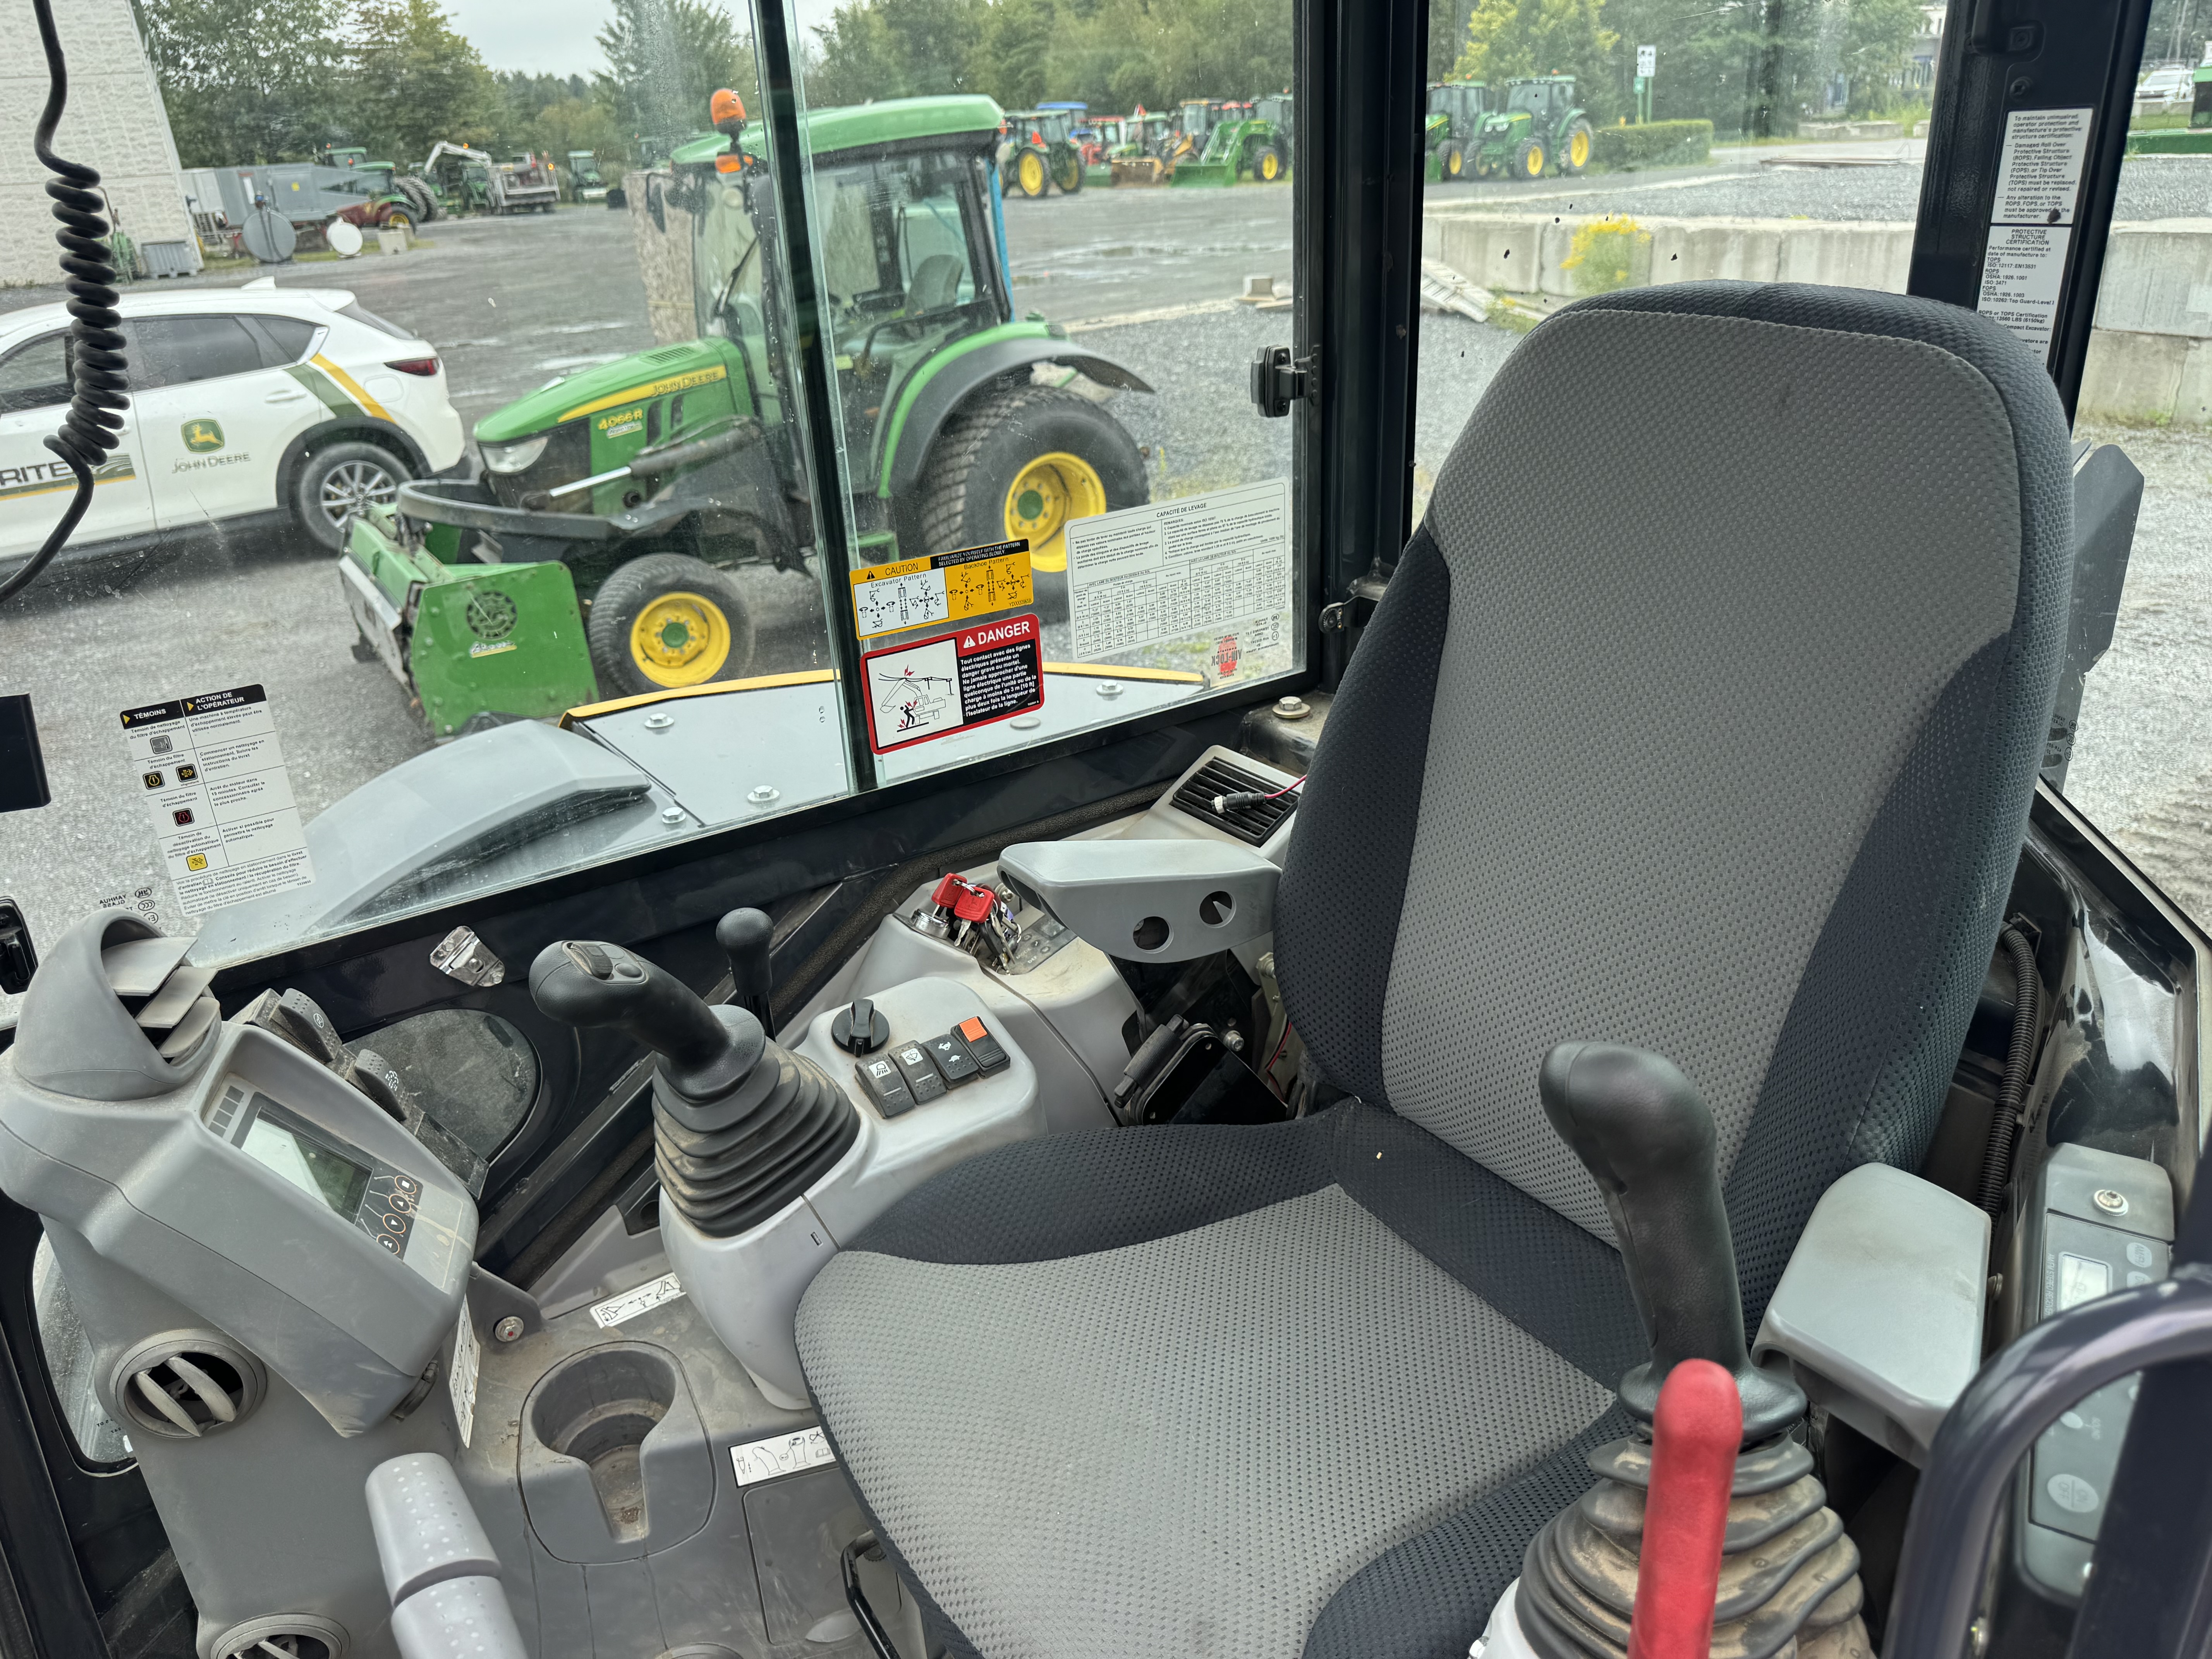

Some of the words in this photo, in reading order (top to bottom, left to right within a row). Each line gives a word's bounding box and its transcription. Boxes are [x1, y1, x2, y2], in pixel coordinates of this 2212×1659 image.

[650, 381, 682, 397] JOHN
[682, 371, 719, 389] DEERE
[598, 408, 643, 430] 4066R
[172, 459, 206, 474] JOHN
[208, 452, 251, 467] DEERE
[0, 460, 96, 486] RITE
[1156, 507, 1180, 518] CAPACITÉ
[1188, 502, 1207, 511] LEVAGE
[884, 562, 918, 576] CAUTION
[870, 578, 901, 588] Excavator
[903, 573, 926, 582] Pattern
[977, 621, 1030, 645] DANGER
[196, 694, 222, 704] ACTION
[197, 696, 245, 711] L'OPÉRATEUR
[133, 708, 166, 719] TÉMOINS
